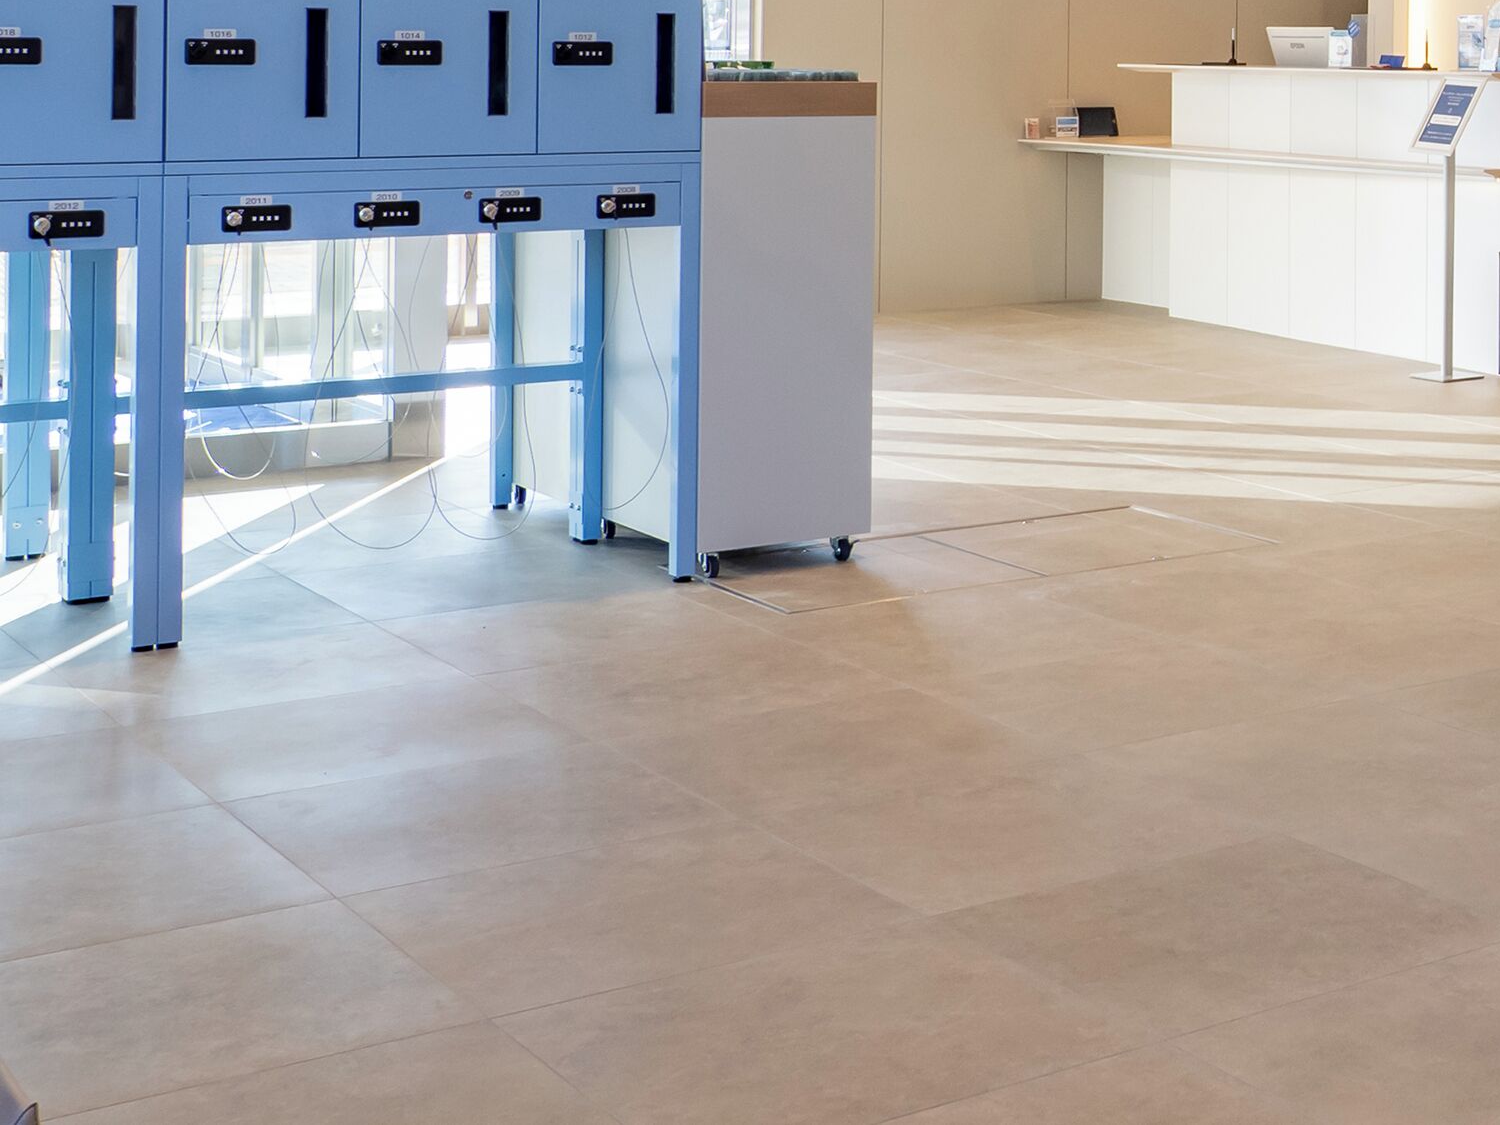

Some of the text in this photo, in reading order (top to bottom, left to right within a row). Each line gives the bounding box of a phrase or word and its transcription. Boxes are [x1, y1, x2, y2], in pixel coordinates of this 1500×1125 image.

[245, 197, 268, 205] 2011
[376, 193, 398, 201] 2010
[54, 203, 79, 211] 2012
